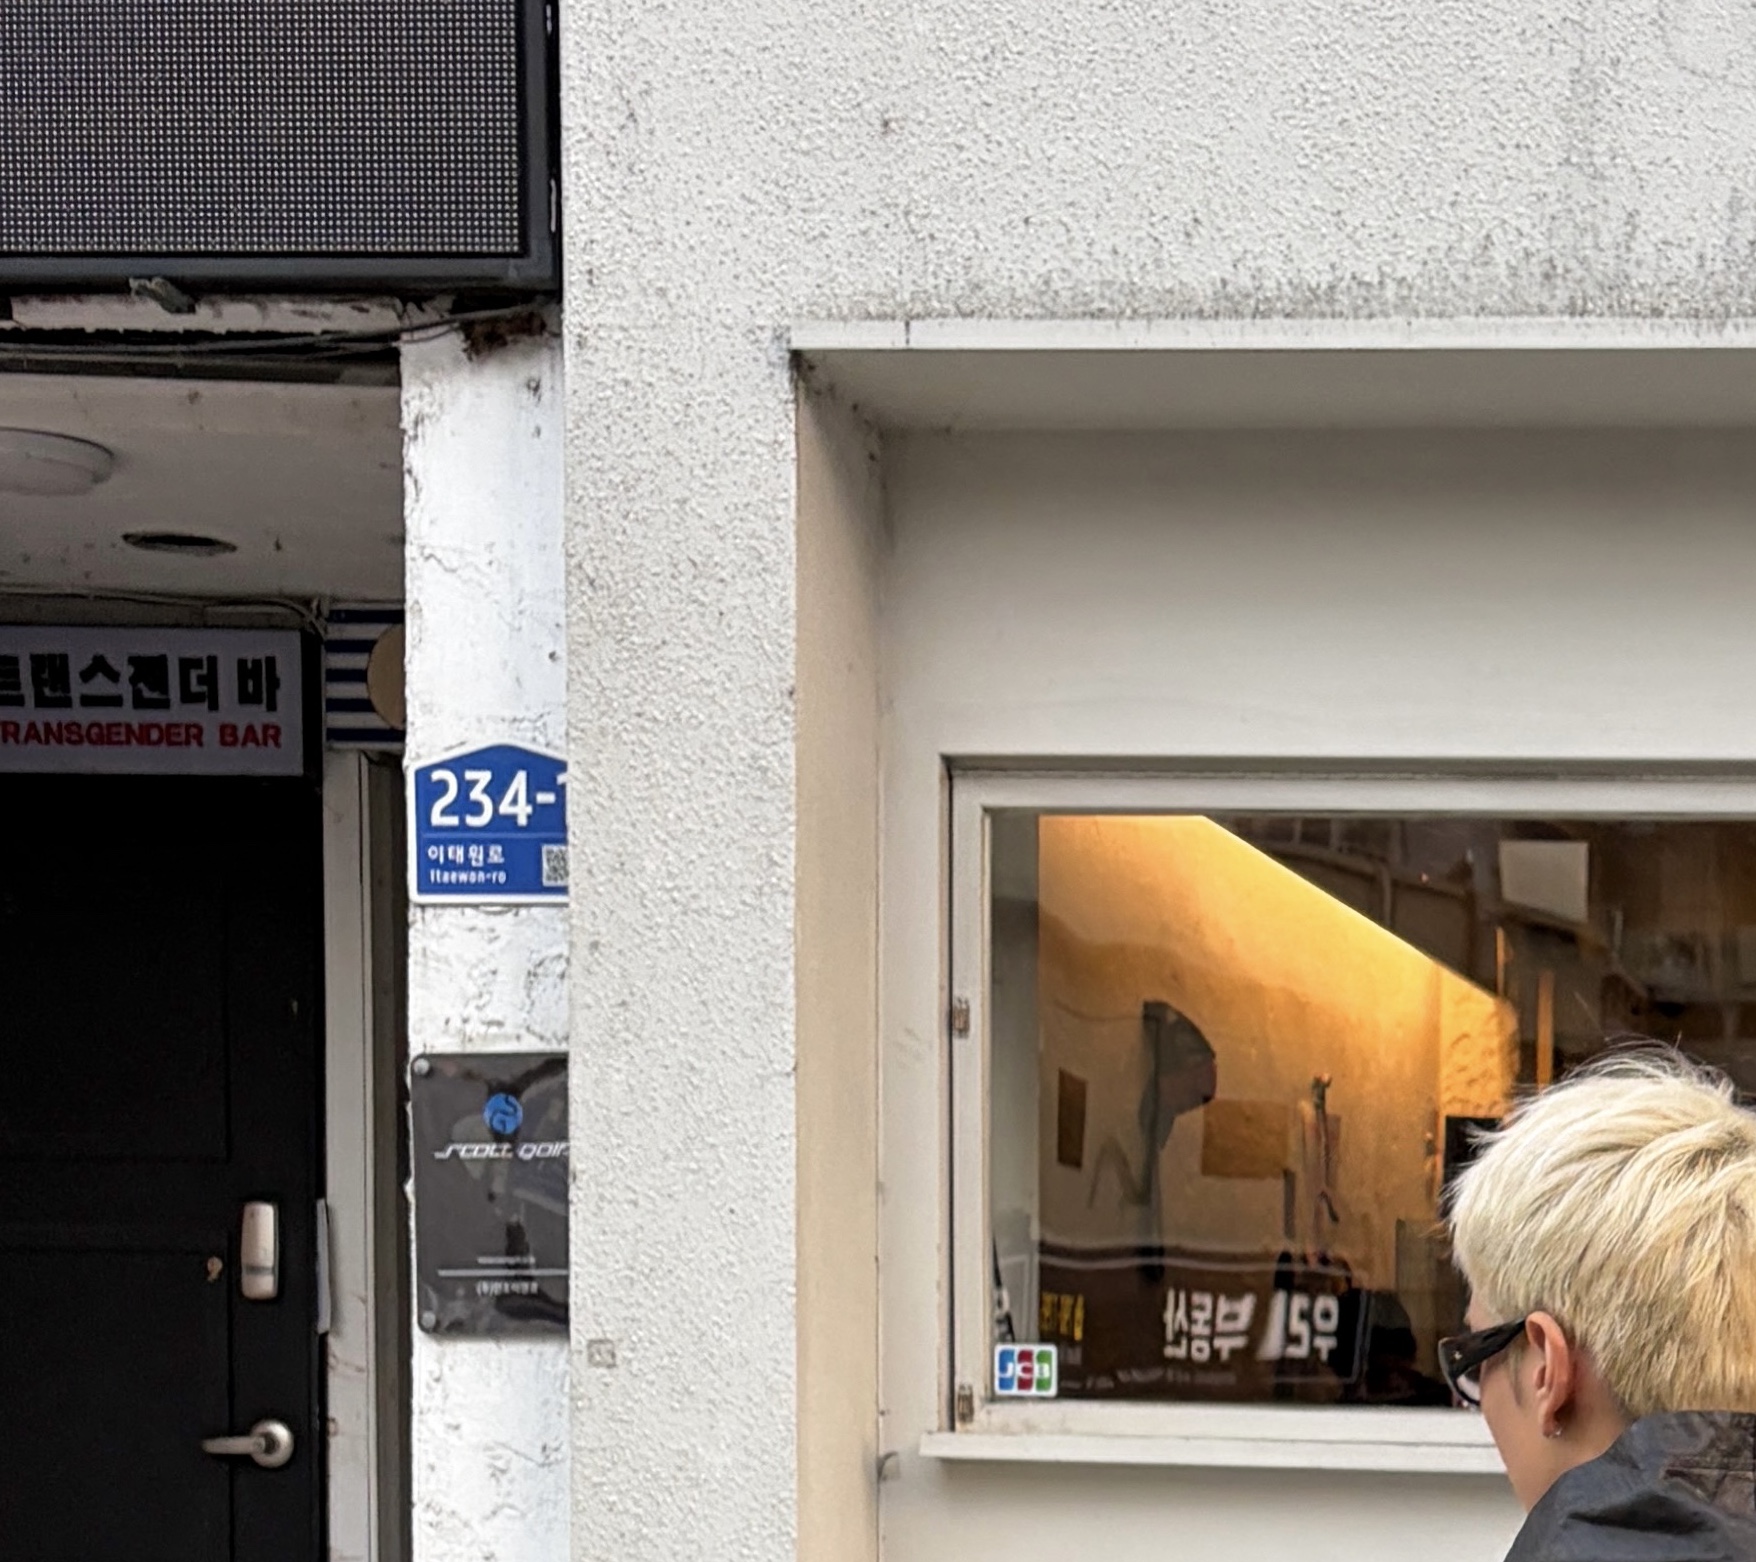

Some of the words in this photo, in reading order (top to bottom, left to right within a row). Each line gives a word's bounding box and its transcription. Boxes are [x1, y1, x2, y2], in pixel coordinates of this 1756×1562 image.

[237, 655, 280, 712] 바
[0, 720, 204, 747] RANSGENDER
[219, 723, 281, 748] BAR
[427, 844, 505, 867] 이태원로
[430, 869, 507, 884] Itaewon-ro
